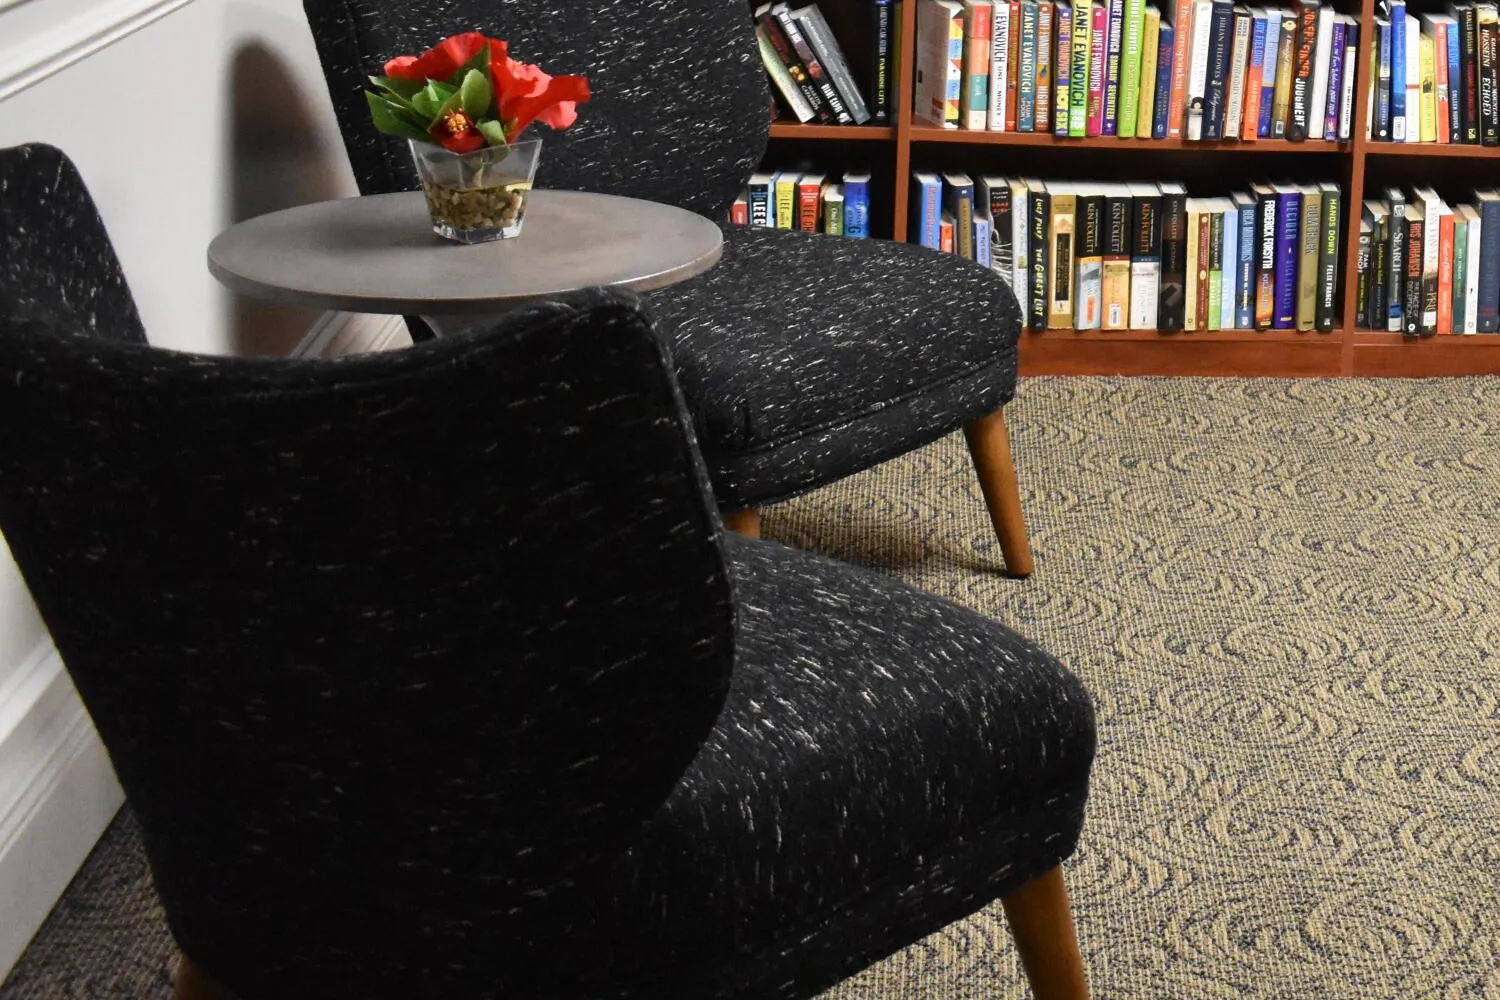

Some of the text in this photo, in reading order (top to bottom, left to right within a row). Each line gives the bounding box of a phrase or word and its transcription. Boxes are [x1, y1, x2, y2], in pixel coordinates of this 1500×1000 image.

[994, 16, 1006, 63] EVANOVICH
[1021, 11, 1036, 93] JANET EVANOVICH
[1071, 4, 1088, 107] JANET EVANOVICH
[1174, 3, 1191, 91] The Correspondent
[1293, 78, 1307, 127] JUDGMENT
[1482, 77, 1492, 116] ECHOED
[1034, 198, 1045, 316] LUCY FOLEY THE GUEST LIST
[1261, 200, 1276, 269] FREDERICK FORSYTH
[1324, 199, 1337, 308] HANDS DOWN FELIX FRANCIS
